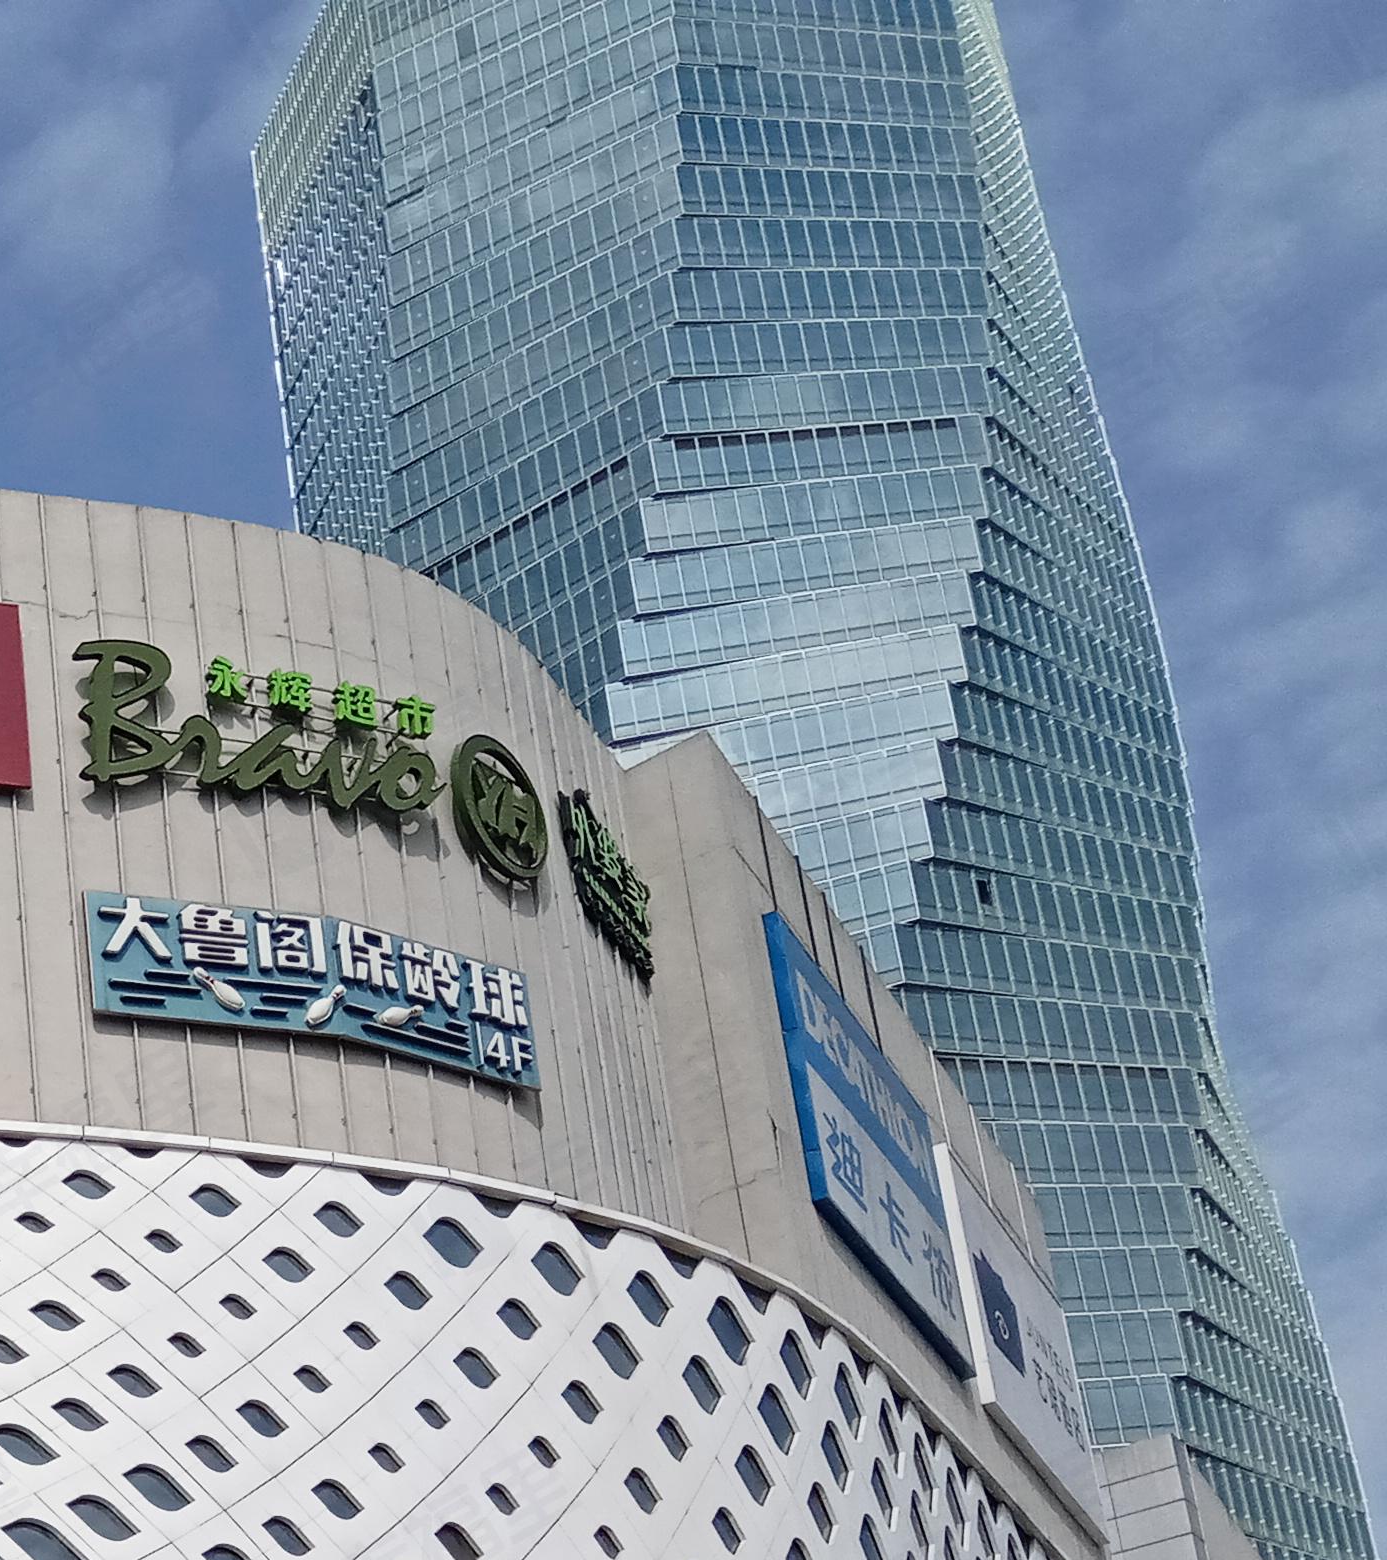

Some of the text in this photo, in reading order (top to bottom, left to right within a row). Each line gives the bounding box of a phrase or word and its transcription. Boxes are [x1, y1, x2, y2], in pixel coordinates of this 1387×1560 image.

[72, 639, 447, 812] Bravo
[204, 654, 436, 739] 永辉超市
[97, 896, 528, 1029] 大鲁阁保龄球
[484, 1032, 534, 1076] 4F
[796, 968, 940, 1200] DECATHLON
